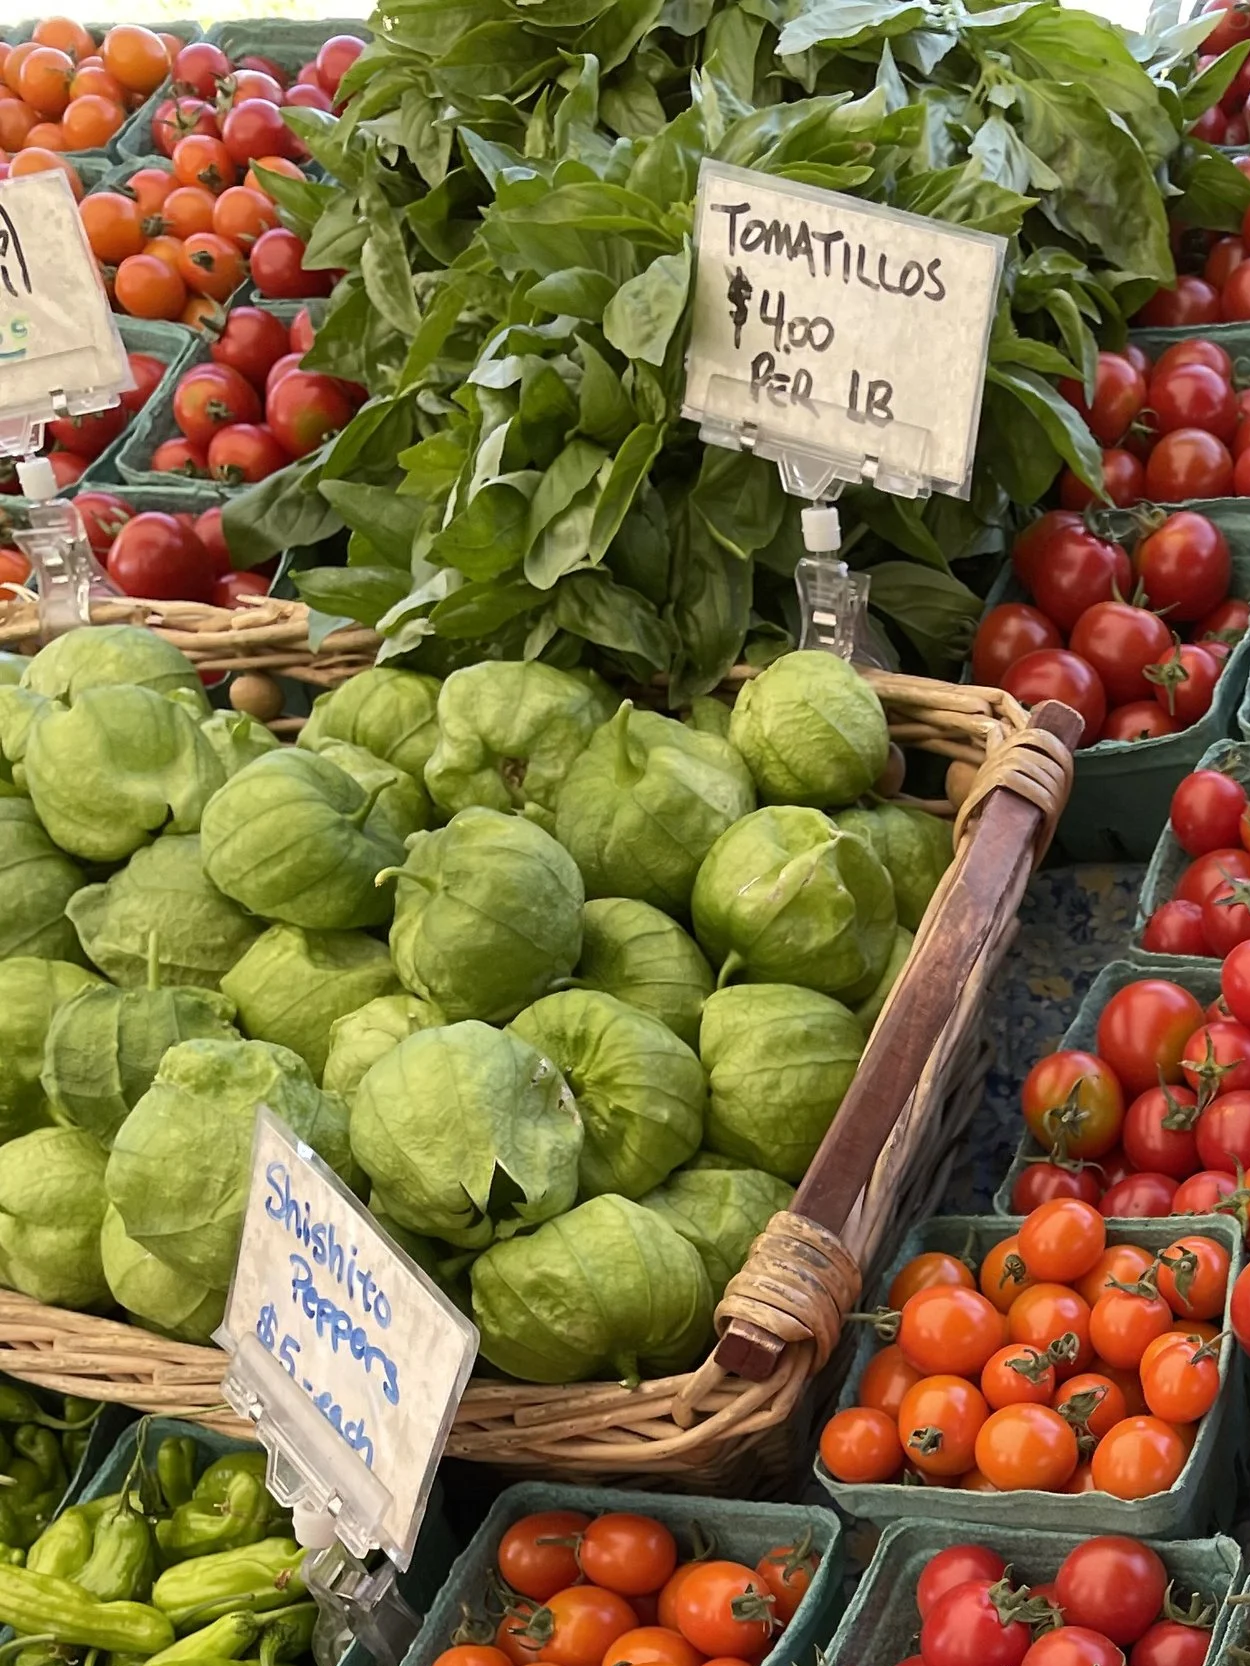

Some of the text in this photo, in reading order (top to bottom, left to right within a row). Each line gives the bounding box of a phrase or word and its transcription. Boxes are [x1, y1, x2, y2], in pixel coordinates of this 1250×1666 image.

[710, 202, 946, 301] TOMATILLOS
[726, 265, 834, 354] $4.00
[750, 351, 820, 419] PER
[265, 1161, 392, 1329] Shishito
[289, 1253, 400, 1406] Peppers
